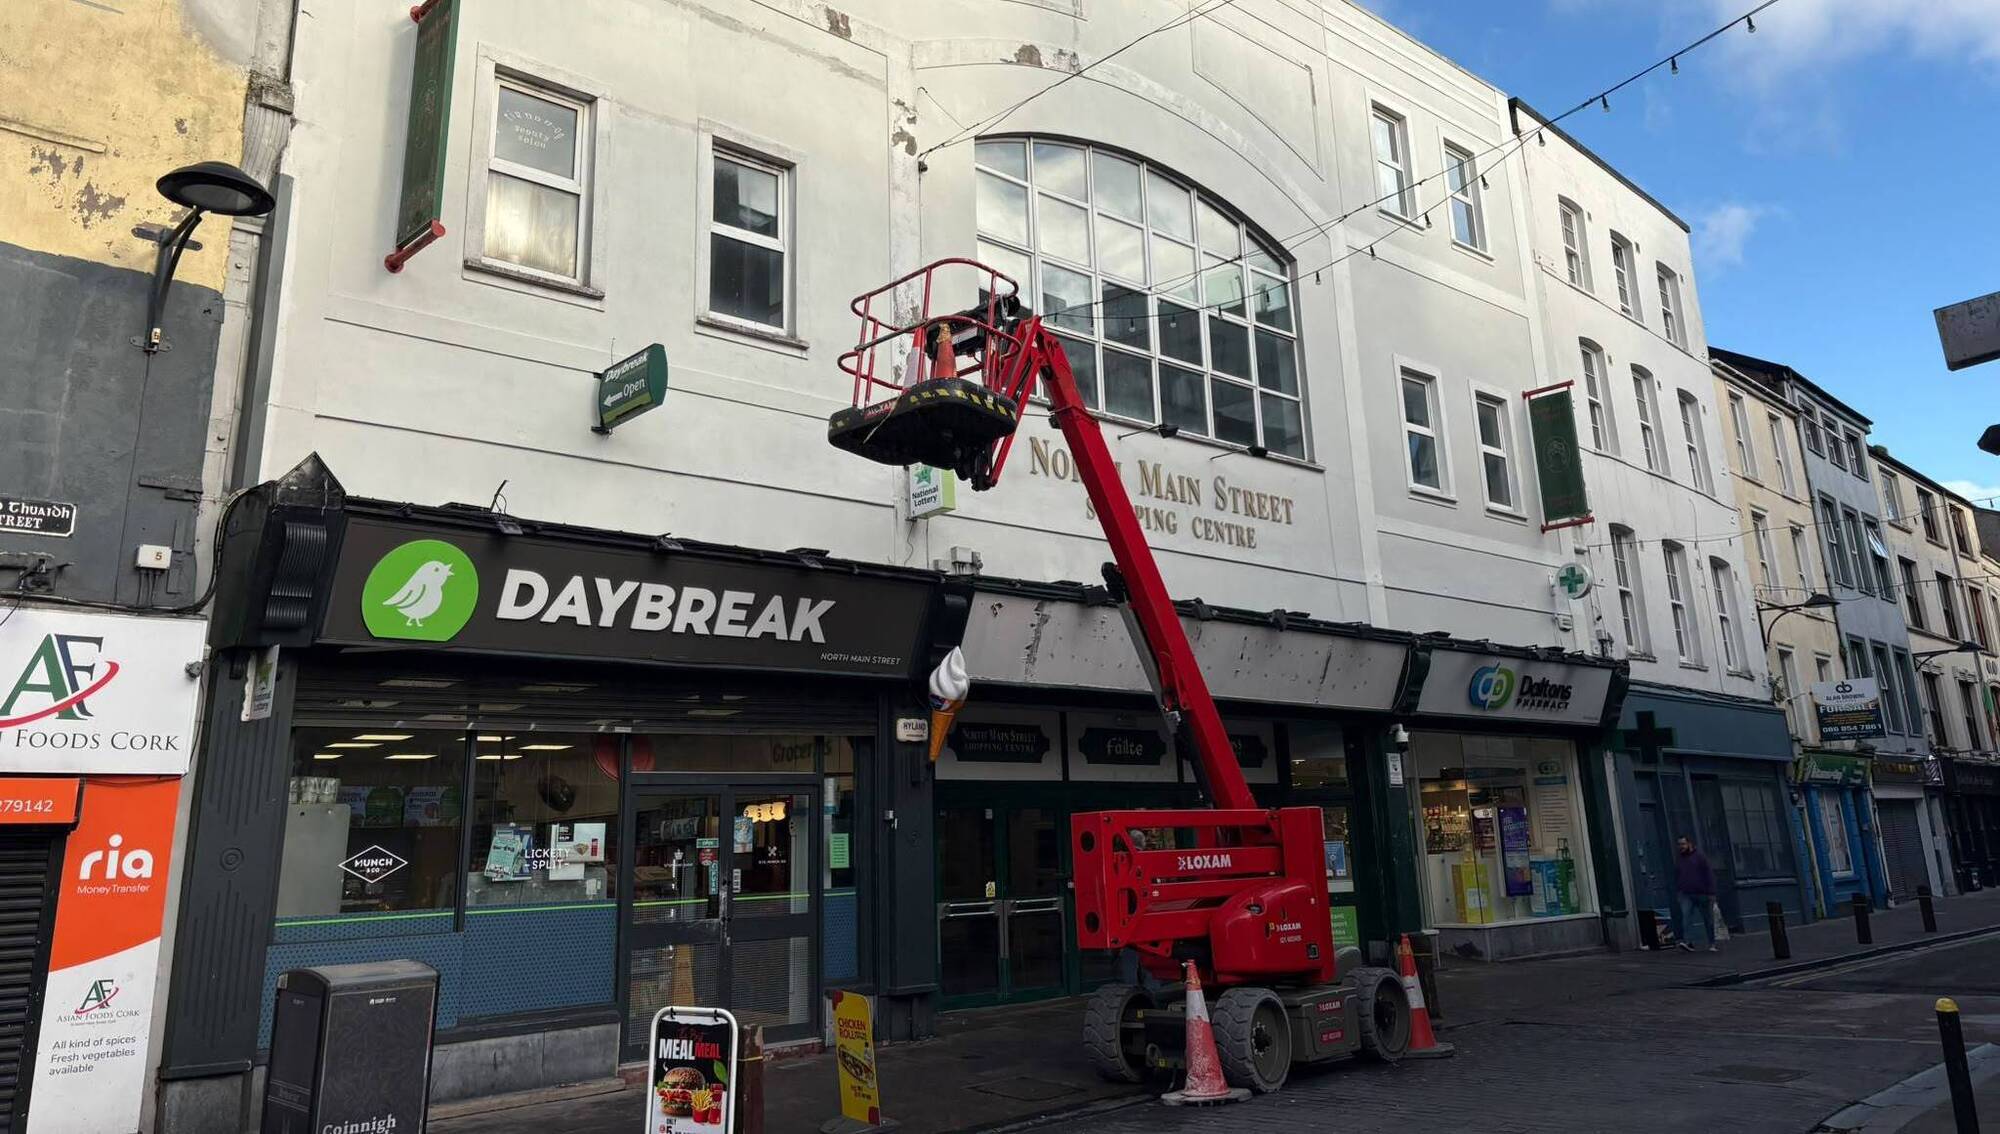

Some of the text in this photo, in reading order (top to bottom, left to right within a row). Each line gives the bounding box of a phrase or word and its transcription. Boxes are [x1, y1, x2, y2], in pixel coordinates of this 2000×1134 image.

[623, 379, 645, 398] Open
[911, 485, 938, 499] National
[1138, 460, 1202, 506] MAIN
[1213, 475, 1294, 525] STREET
[914, 494, 938, 507] Lottery
[9, 501, 70, 519] Thuaidh
[1086, 497, 1257, 549] SPING CENTRE
[155, 552, 163, 561] 5
[496, 567, 836, 644] DAYBREAK
[820, 652, 901, 665] NORTH MAIN STREET
[1519, 675, 1573, 701] Daltons
[1516, 698, 1570, 710] PHARMACY
[1820, 702, 1876, 713] FOR SALE
[15, 729, 101, 750] FOODS
[111, 732, 181, 751] CORK
[0, 799, 54, 812] 79142
[79, 834, 153, 880] ria
[525, 848, 570, 859] LICKETY
[354, 858, 393, 868] MUNCH
[1186, 854, 1232, 869] LOXAM
[77, 884, 150, 896] Money Transfer
[1280, 922, 1302, 932] LOXAM
[57, 1014, 82, 1023] ASIAN
[85, 1012, 114, 1021] FOODS
[116, 1010, 140, 1018] CORK
[52, 1035, 136, 1050] All kind of spices
[659, 1038, 695, 1060] MEAL
[50, 1047, 136, 1063] Fresh vegetables
[49, 1064, 94, 1076] available
[322, 1113, 397, 1134] Coinnigh
